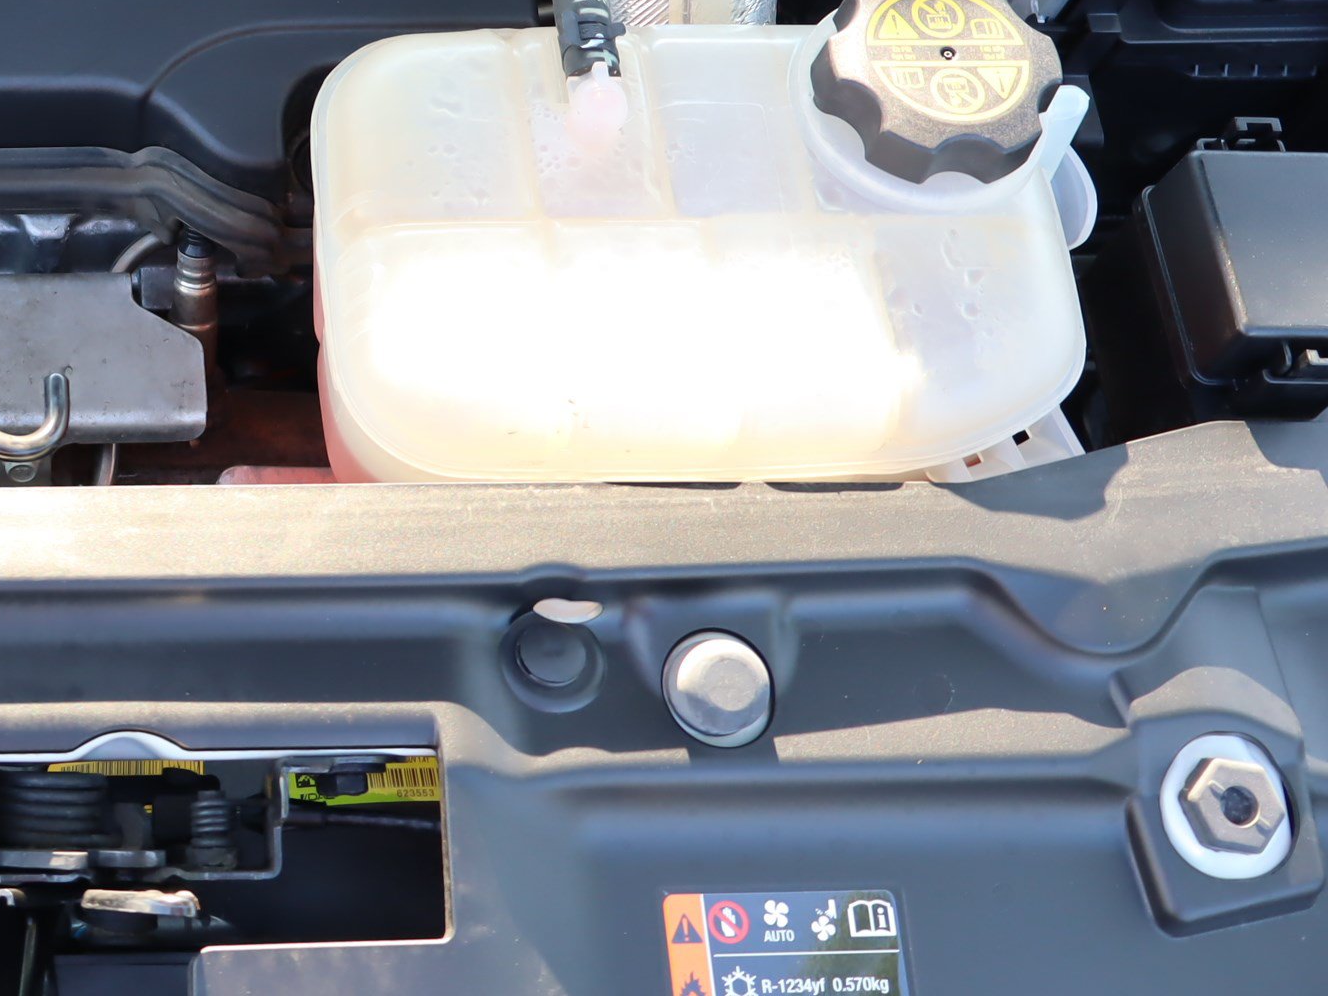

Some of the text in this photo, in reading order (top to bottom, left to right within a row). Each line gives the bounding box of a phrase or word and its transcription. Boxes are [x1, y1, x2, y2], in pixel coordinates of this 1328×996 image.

[396, 788, 435, 798] 623553
[763, 929, 795, 942] AUTO
[761, 976, 890, 994] R-1234yf 0.570kg
